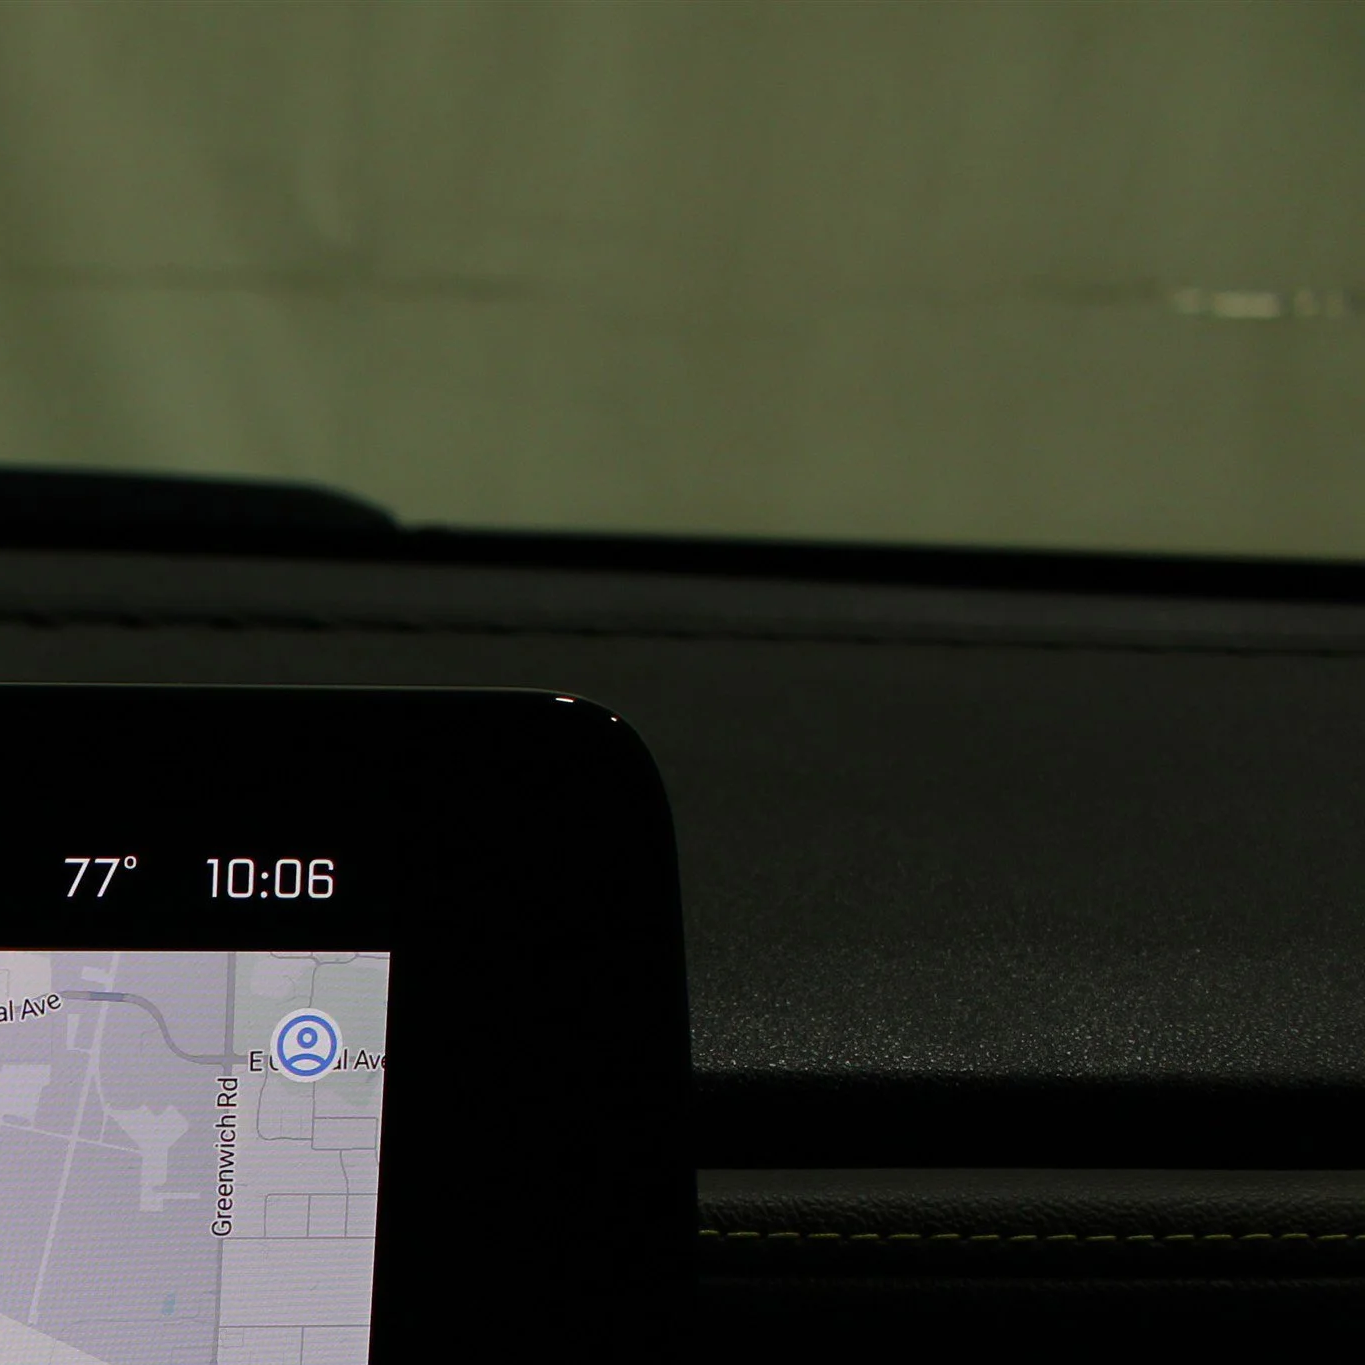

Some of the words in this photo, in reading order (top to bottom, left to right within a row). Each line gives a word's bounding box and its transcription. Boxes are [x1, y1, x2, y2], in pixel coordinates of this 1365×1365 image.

[64, 855, 137, 898] 77°
[206, 858, 334, 899] 10:06
[21, 994, 61, 1020] Ave
[249, 1050, 263, 1072] E
[216, 1078, 238, 1107] Rd
[211, 1113, 236, 1237] Greenwich
